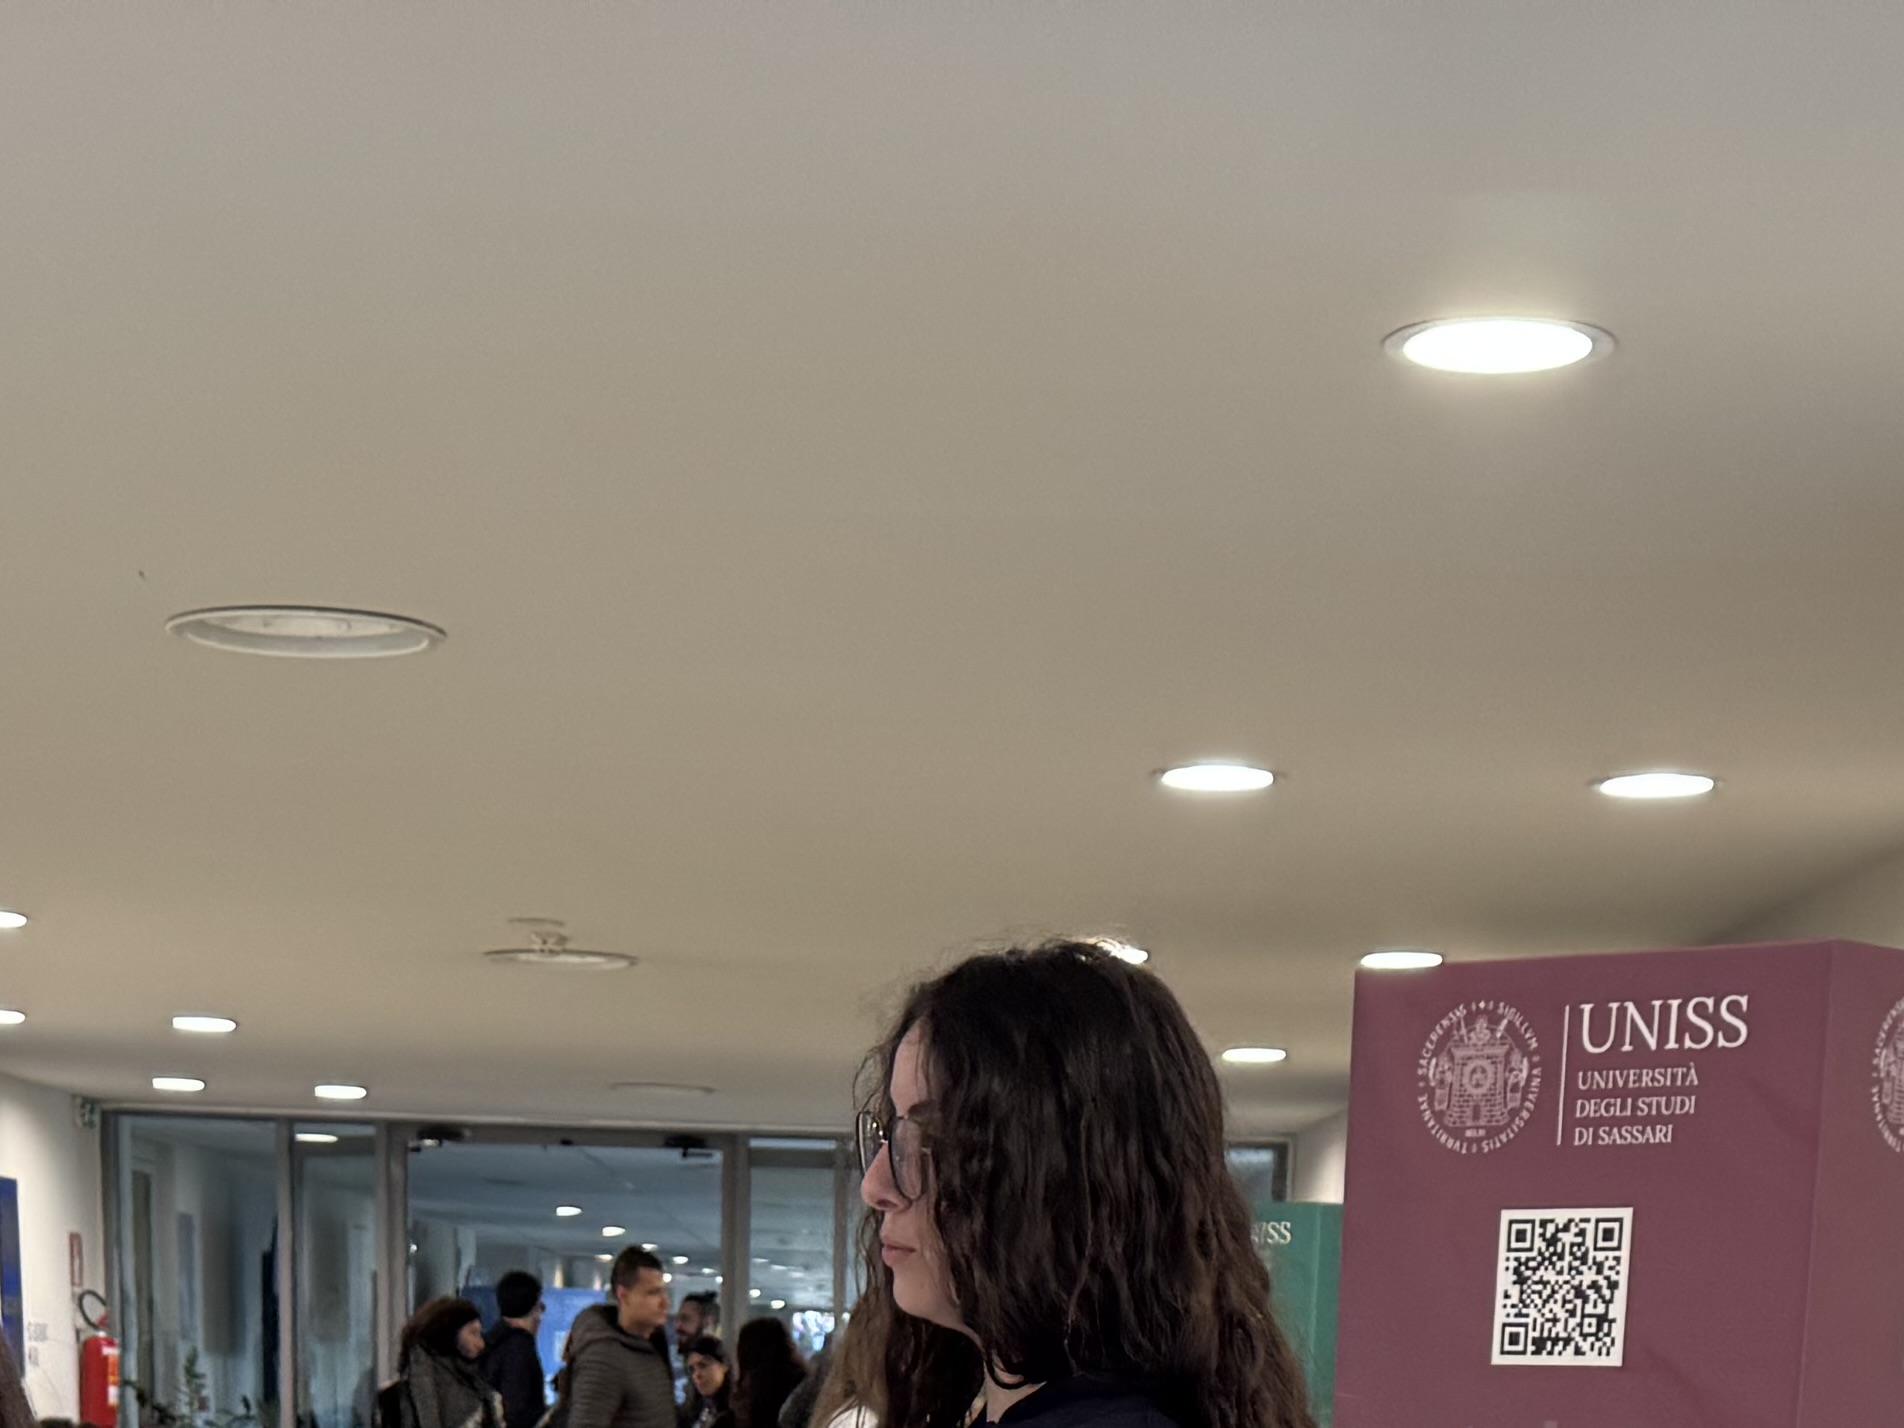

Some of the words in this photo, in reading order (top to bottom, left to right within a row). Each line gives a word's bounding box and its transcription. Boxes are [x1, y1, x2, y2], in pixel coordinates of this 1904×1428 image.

[1579, 995, 1749, 1054] UNISS
[1577, 1062, 1699, 1090] UNIVERSITÀ
[1575, 1097, 1633, 1118] DEGLI
[1637, 1095, 1696, 1116] STUDI
[1574, 1128, 1593, 1146] DI
[1597, 1124, 1673, 1145] SASSARI
